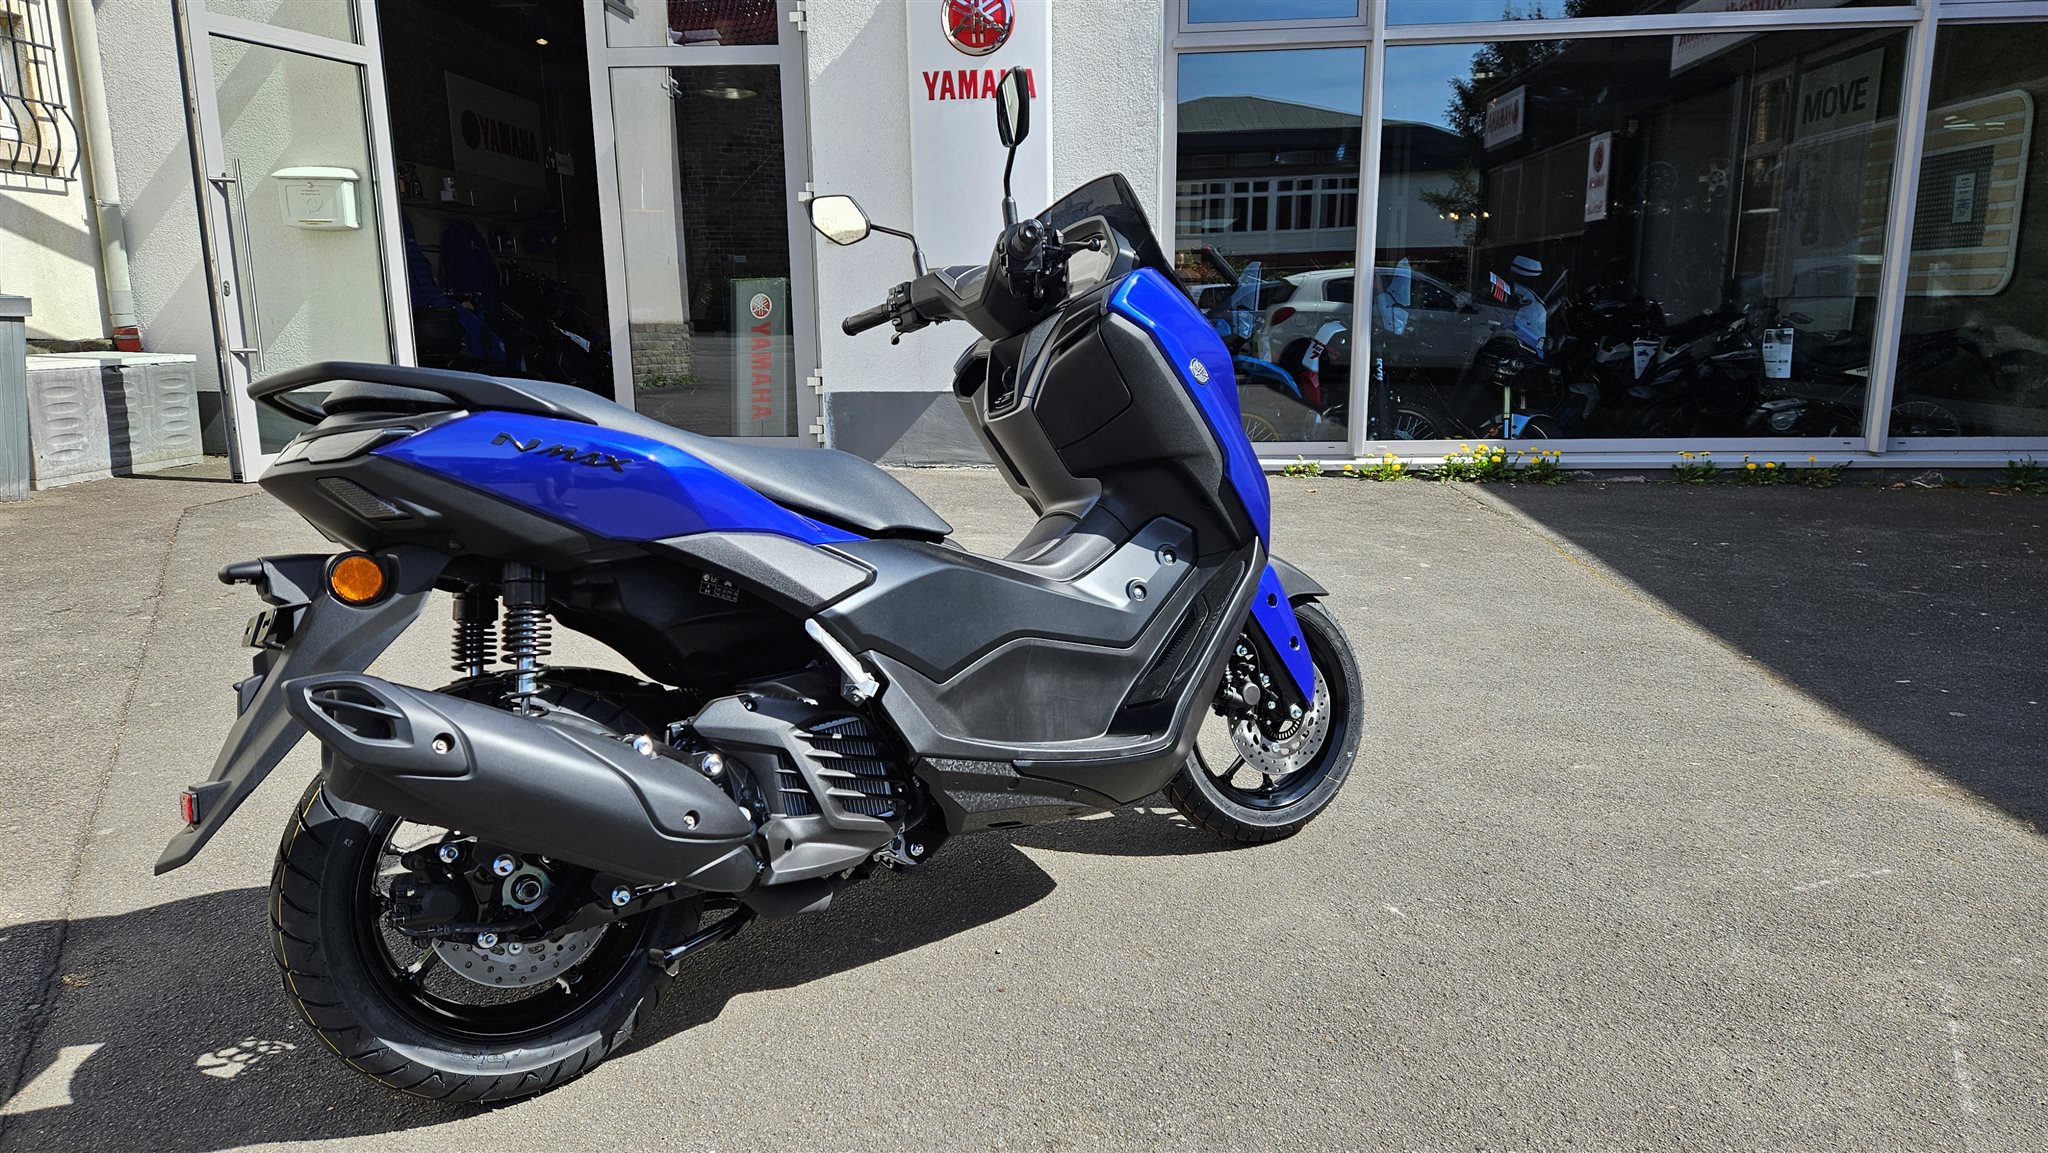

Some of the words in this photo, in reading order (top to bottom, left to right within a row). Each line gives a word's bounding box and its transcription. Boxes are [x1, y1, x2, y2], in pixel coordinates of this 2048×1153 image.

[922, 68, 1037, 101] YAMAA
[1802, 76, 1879, 125] MOVE
[479, 114, 538, 162] YAMAHA
[751, 320, 773, 420] YAMAHA
